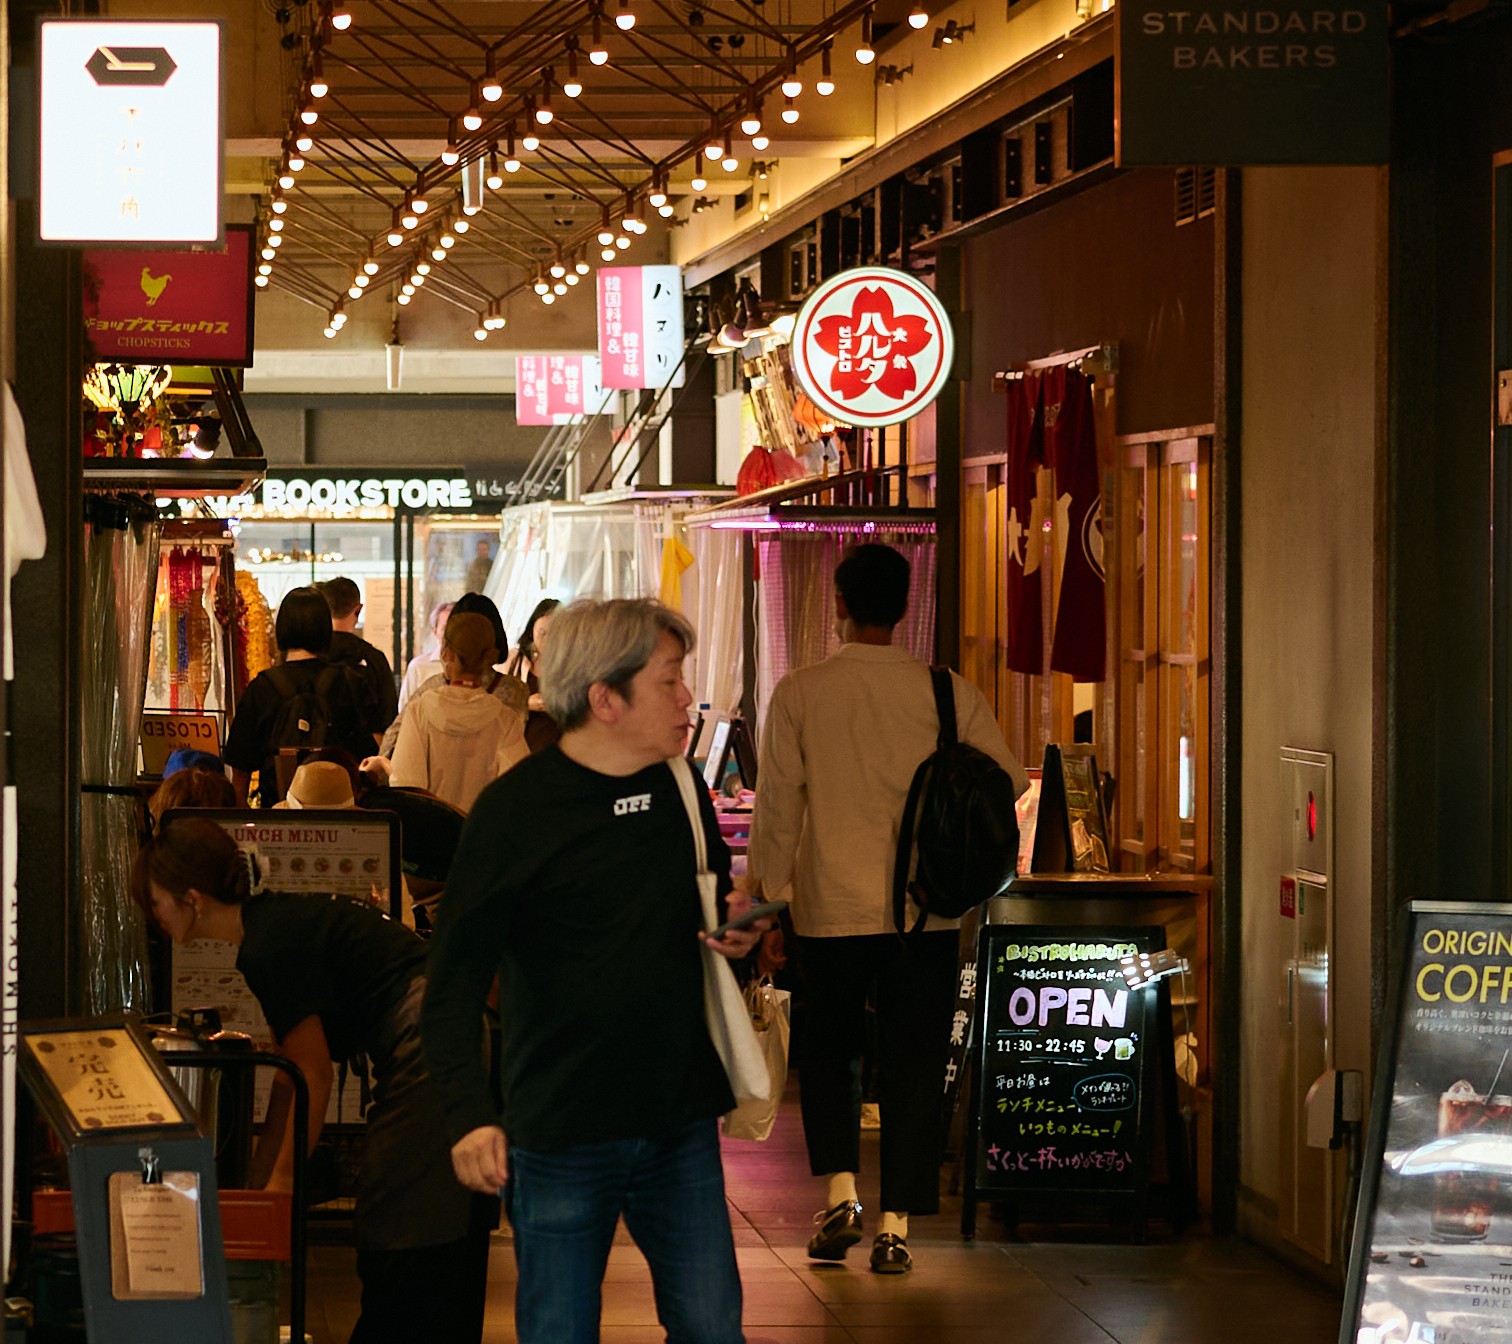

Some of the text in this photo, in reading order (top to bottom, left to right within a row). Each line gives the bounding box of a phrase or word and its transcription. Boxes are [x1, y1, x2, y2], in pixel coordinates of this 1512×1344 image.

[1142, 10, 1367, 35] STANDARD
[1173, 45, 1337, 69] BAKERS
[117, 336, 191, 348] CHOPSTICKS
[838, 326, 852, 373] ビストロ
[852, 312, 892, 384] ハルタ
[262, 478, 473, 511] BOOKSTORE
[144, 720, 212, 738] CLOSED
[225, 828, 339, 843] UNCH MENU
[1008, 986, 1128, 1028] OPEN
[943, 962, 977, 1094] 営業中
